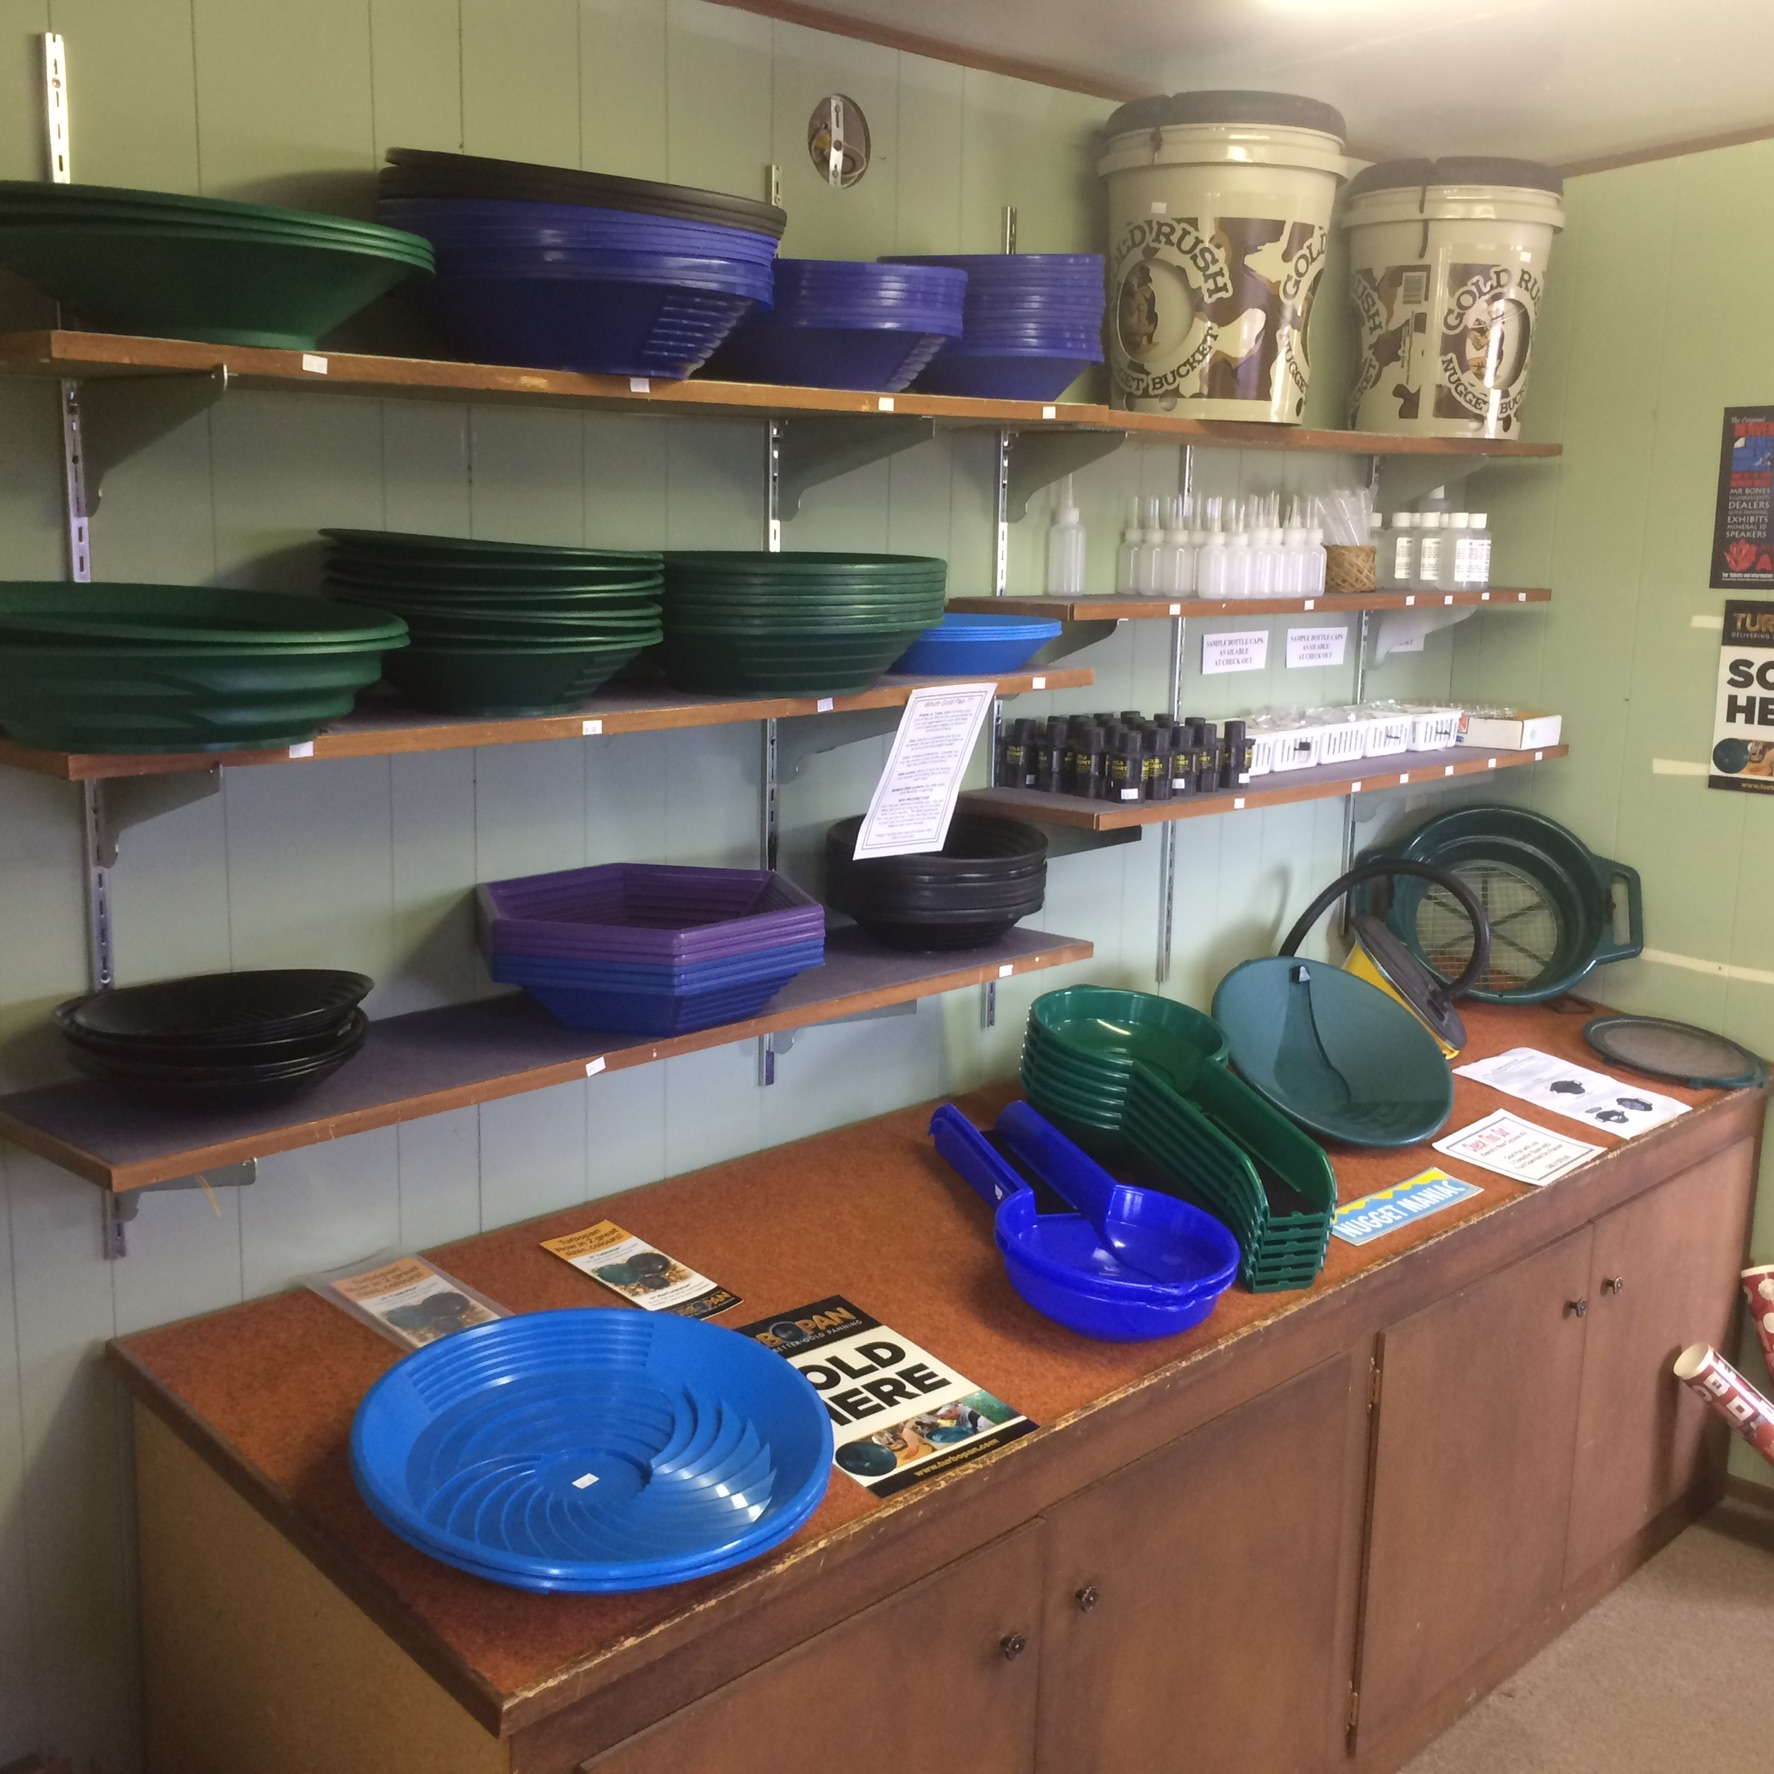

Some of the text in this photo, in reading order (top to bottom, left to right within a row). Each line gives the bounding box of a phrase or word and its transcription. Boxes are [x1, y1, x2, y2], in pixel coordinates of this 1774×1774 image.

[1152, 220, 1229, 299] RUSH
[1443, 268, 1512, 332] GOLD
[1151, 326, 1219, 391] BUCKET
[1441, 357, 1491, 413] NUGGE
[1744, 487, 1771, 495] BONES
[1728, 501, 1770, 509] DEALERS
[1727, 515, 1769, 524] EXHIBITS
[1725, 530, 1767, 538] SPEAKERS
[1290, 633, 1344, 642] SAMPLE BOTTLE CAPS
[1730, 631, 1770, 640] DELIVERING
[1206, 637, 1264, 648] SAMPLE BOTTLE CAPS
[1302, 642, 1330, 650] AVAILABLE
[1218, 647, 1249, 656] AVAILABLE
[1305, 652, 1322, 660] CHECK
[1322, 651, 1333, 660] OUT
[1214, 656, 1253, 667] AT CHECK OUT
[1333, 1180, 1466, 1238] NUGGET MANIAC
[754, 1306, 857, 1348] BOPAN
[803, 1331, 825, 1344] GOLD
[826, 1319, 863, 1335] PANNING
[797, 1341, 906, 1391] OLD
[914, 1438, 1000, 1476] www.turbopan.com
